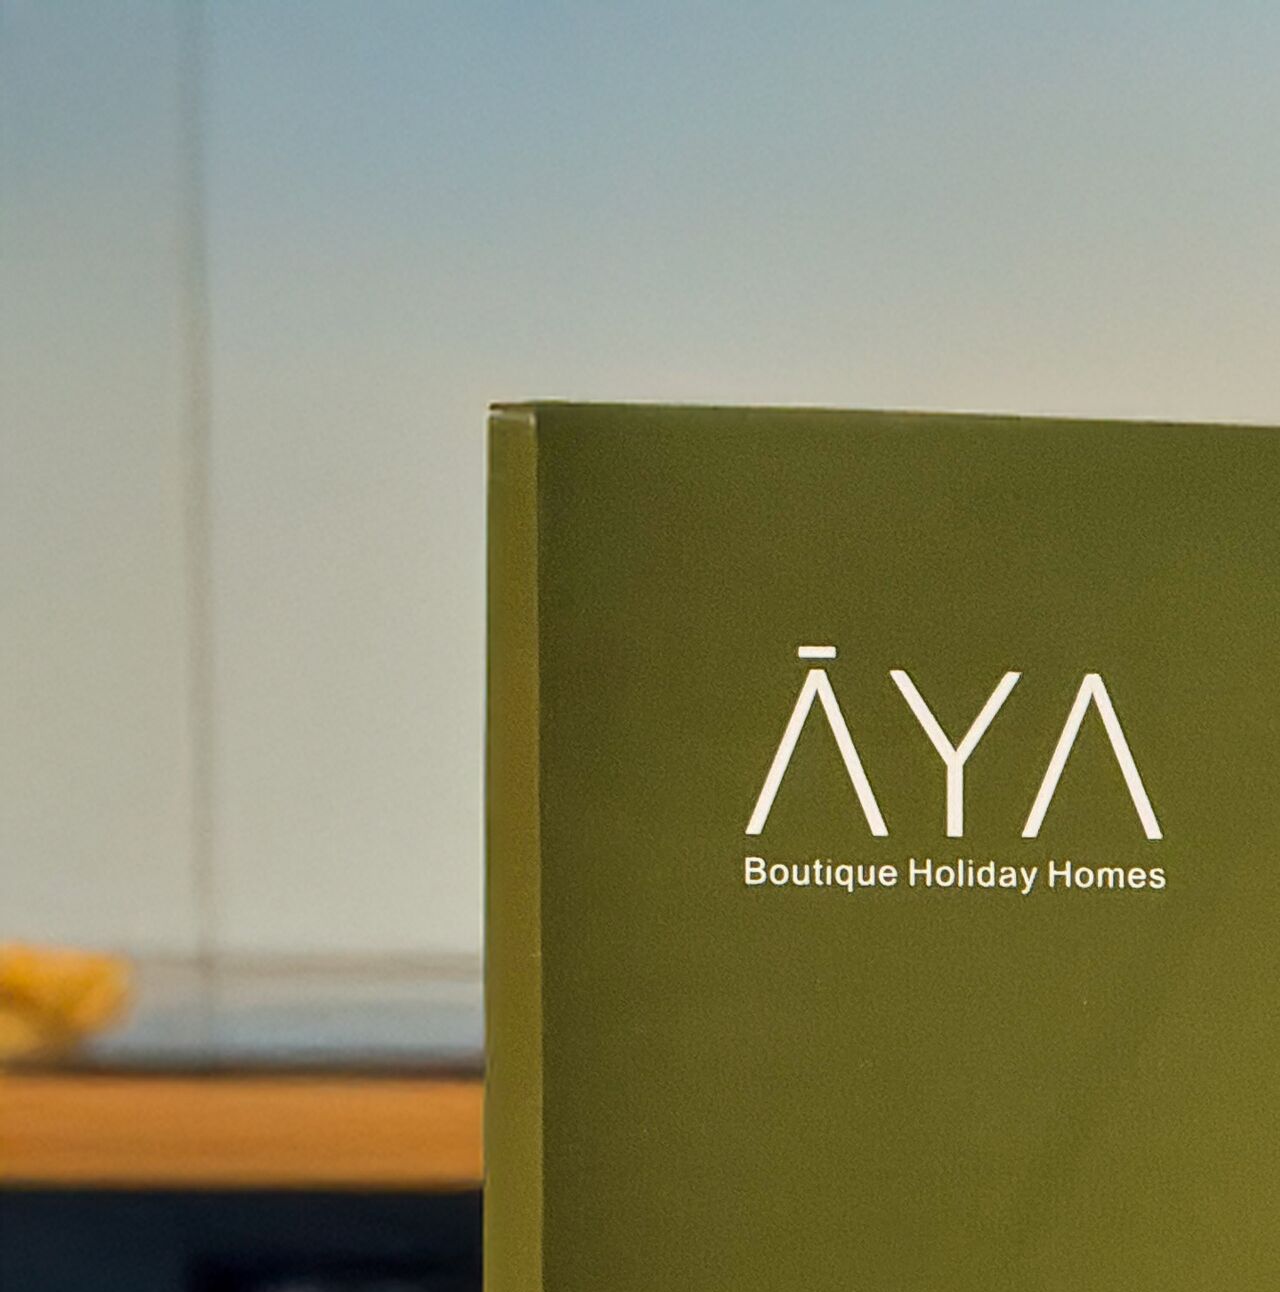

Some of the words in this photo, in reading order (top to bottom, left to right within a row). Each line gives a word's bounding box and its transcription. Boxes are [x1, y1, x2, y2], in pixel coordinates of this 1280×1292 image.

[743, 856, 898, 892] Boutique
[908, 858, 1038, 894] Holiday
[1048, 861, 1166, 890] Homes
